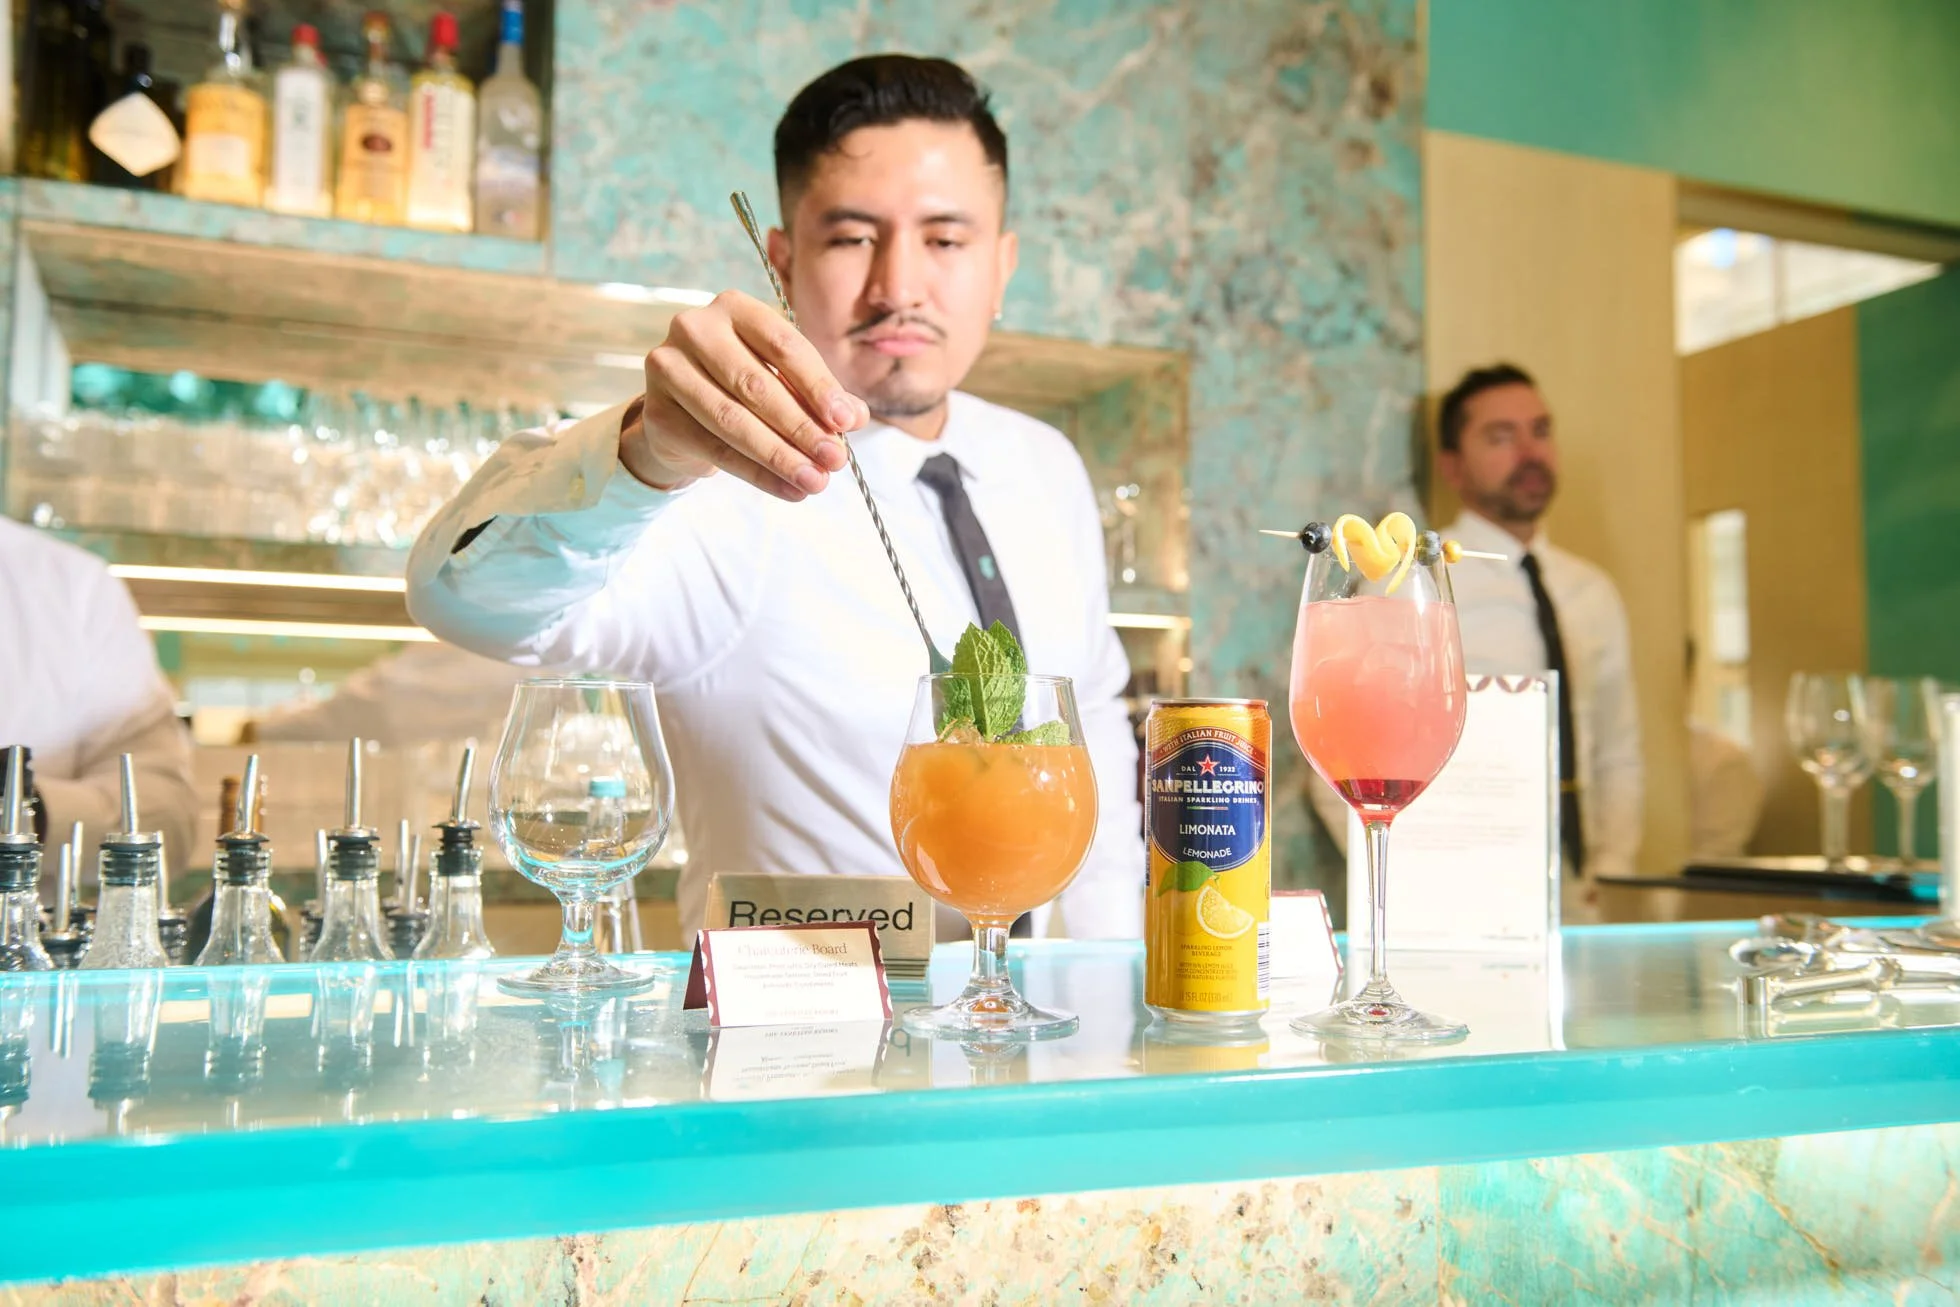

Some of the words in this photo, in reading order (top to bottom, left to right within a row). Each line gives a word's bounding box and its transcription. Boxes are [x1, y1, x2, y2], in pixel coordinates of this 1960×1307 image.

[1162, 739, 1179, 752] WITH
[1180, 730, 1212, 743] ITALIAN
[1214, 730, 1237, 742] FRUIT
[1236, 739, 1254, 755] JUICE
[1152, 779, 1264, 794] SANPELLEGRINO
[1180, 824, 1236, 836] LIMONATA
[1183, 847, 1232, 859] LEMONADE
[729, 901, 913, 931] Reserved
[812, 942, 848, 955] Board
